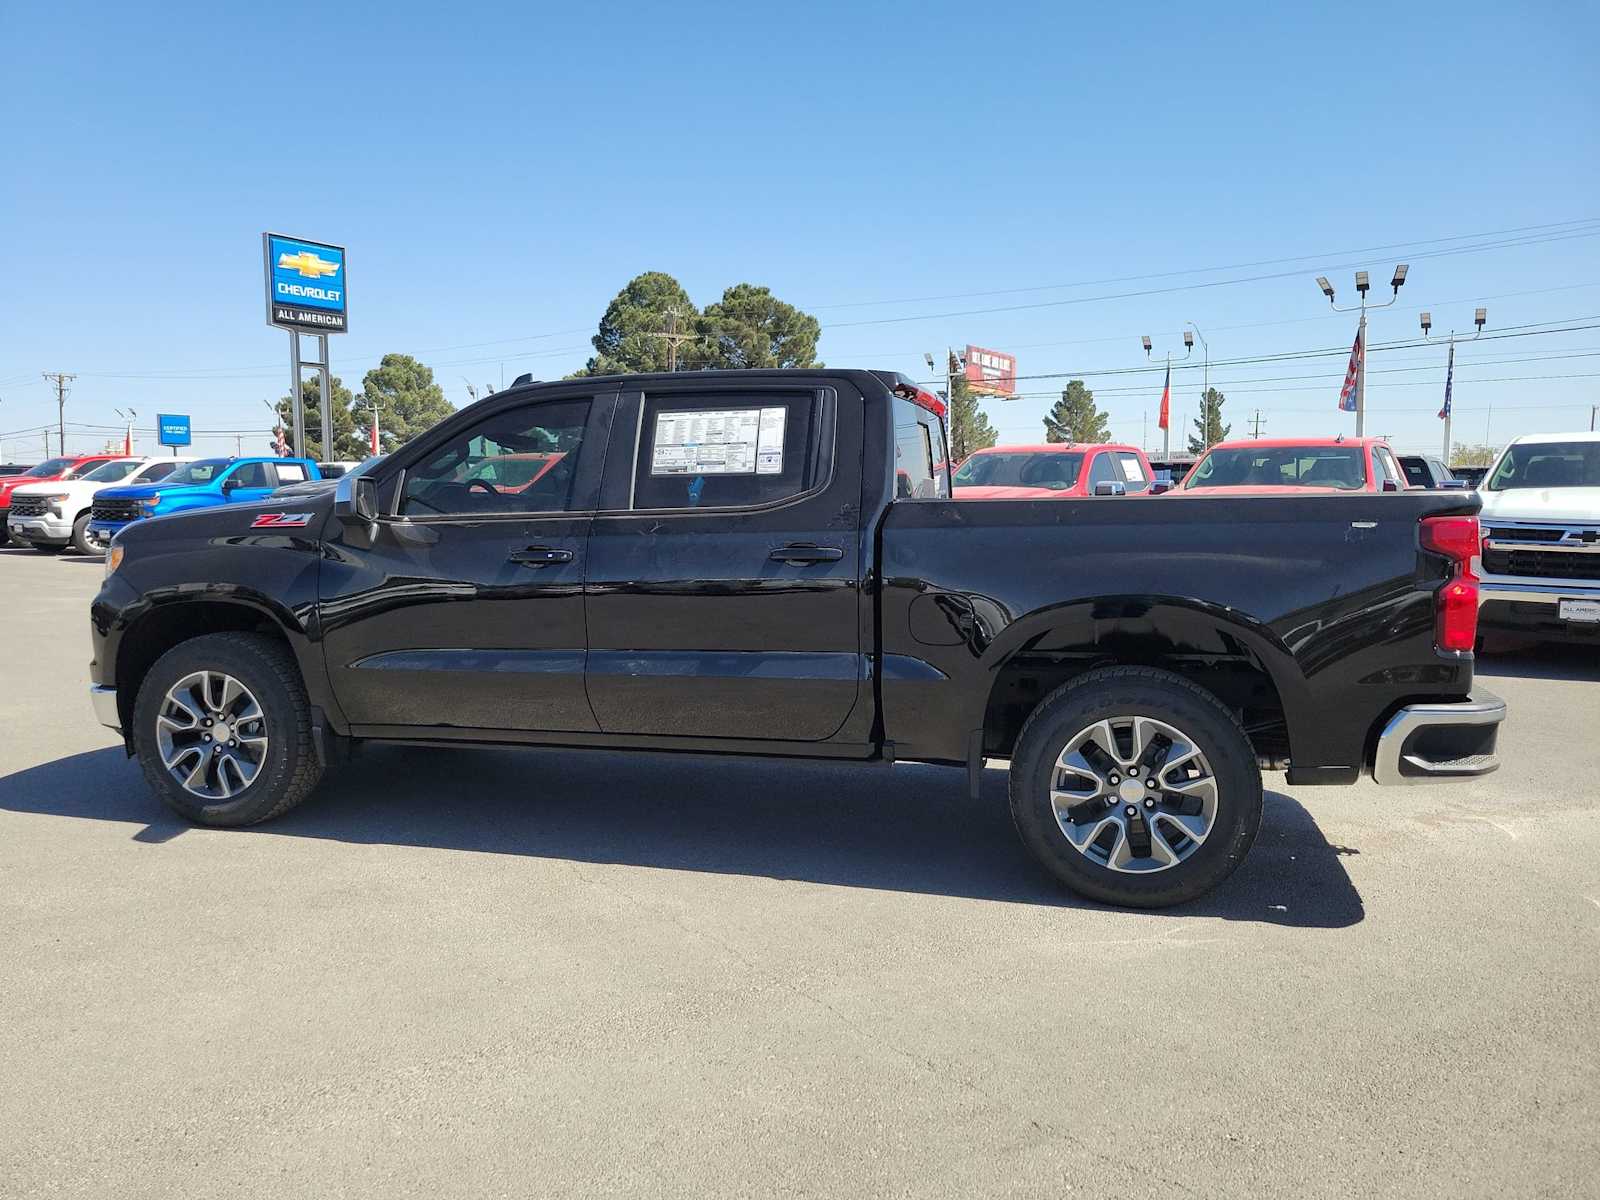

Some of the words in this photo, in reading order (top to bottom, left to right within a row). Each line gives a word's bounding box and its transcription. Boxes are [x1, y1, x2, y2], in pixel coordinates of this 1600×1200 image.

[277, 282, 341, 302] CHEVROLET
[278, 309, 296, 321] ALL
[298, 311, 343, 326] AMERICAN
